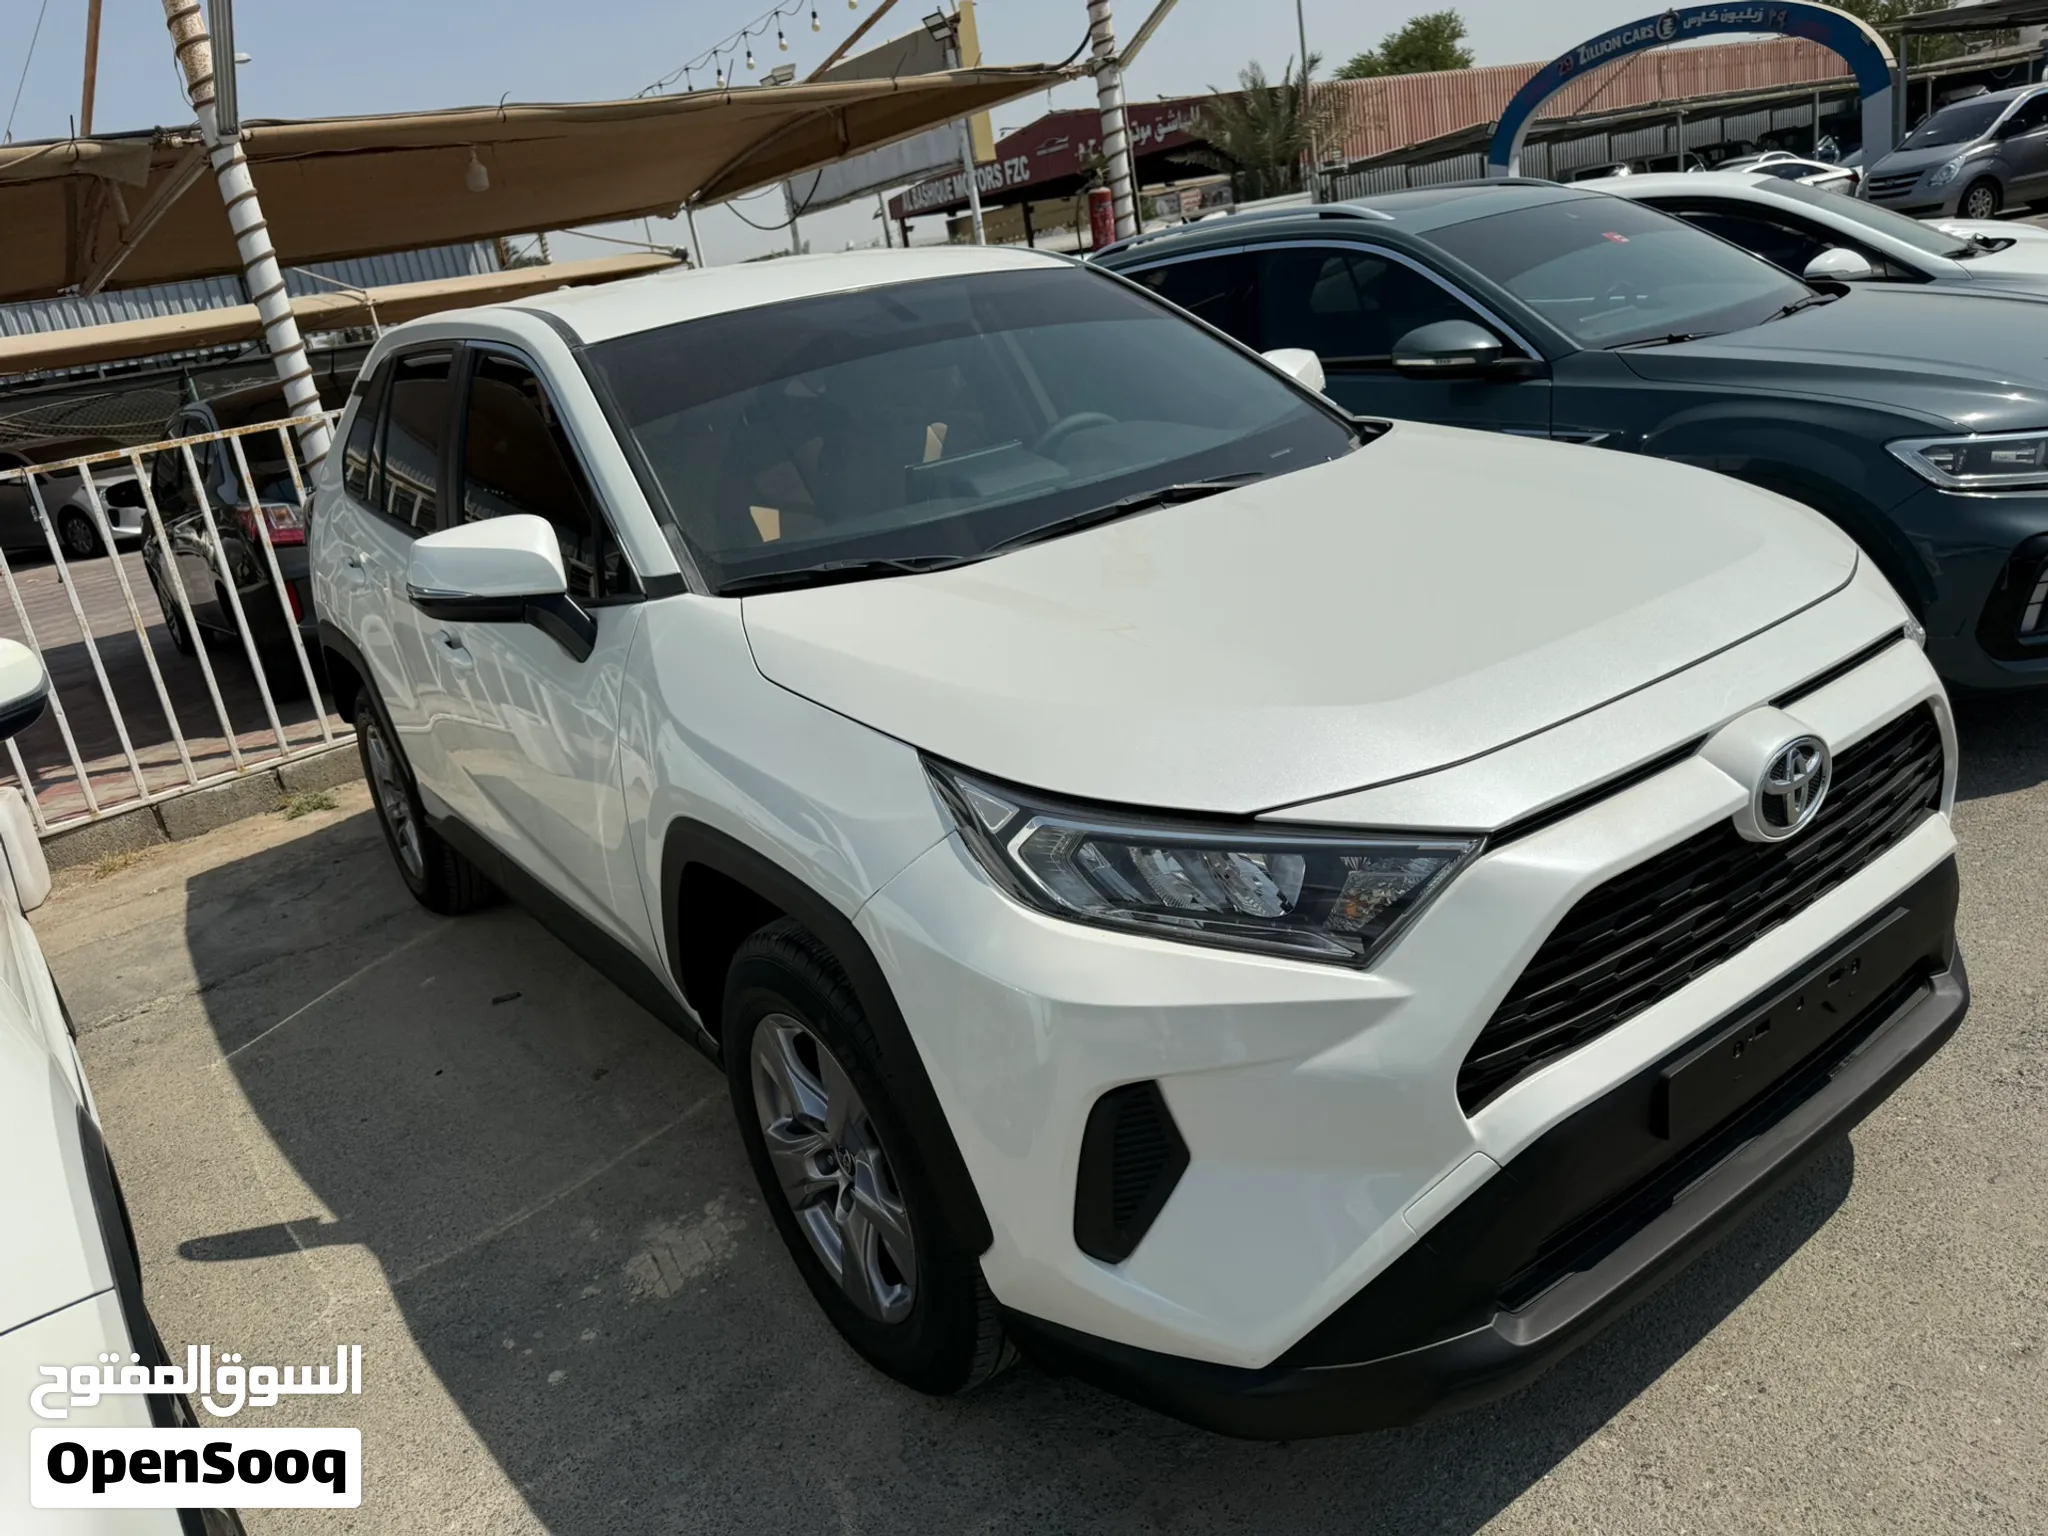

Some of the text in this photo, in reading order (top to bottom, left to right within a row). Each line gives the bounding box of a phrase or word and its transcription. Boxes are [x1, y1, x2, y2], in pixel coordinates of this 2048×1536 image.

[1558, 54, 1574, 76] 29
[1576, 34, 1623, 65] ZILLION
[1622, 24, 1655, 45] CARS
[1004, 155, 1031, 186] FZC
